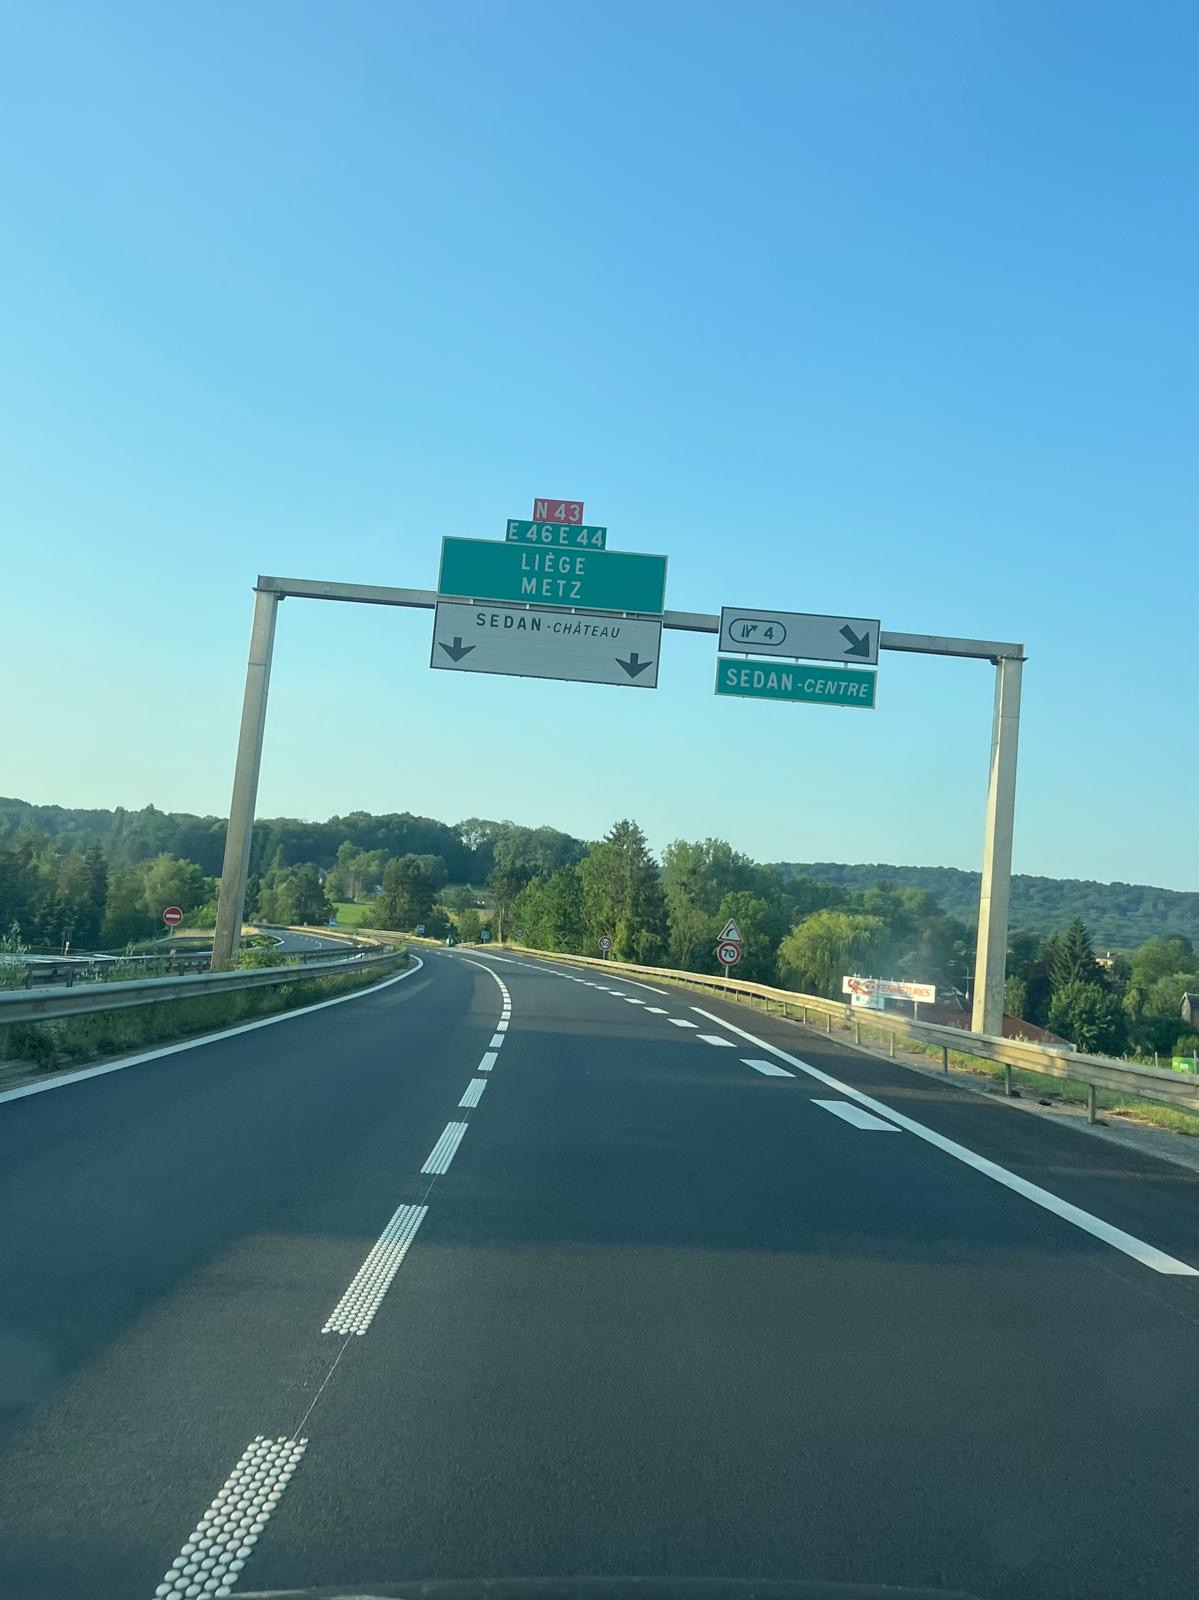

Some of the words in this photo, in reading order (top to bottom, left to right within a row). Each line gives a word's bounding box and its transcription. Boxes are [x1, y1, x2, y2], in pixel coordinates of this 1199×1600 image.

[536, 502, 549, 519] N
[554, 503, 580, 522] 43
[509, 522, 520, 540] E
[526, 525, 553, 543] 46
[559, 527, 570, 544] E
[576, 529, 603, 547] 44
[521, 552, 585, 575] LIÈGE
[521, 577, 582, 599] METZ
[763, 626, 774, 640] 4
[723, 948, 736, 959] 70
